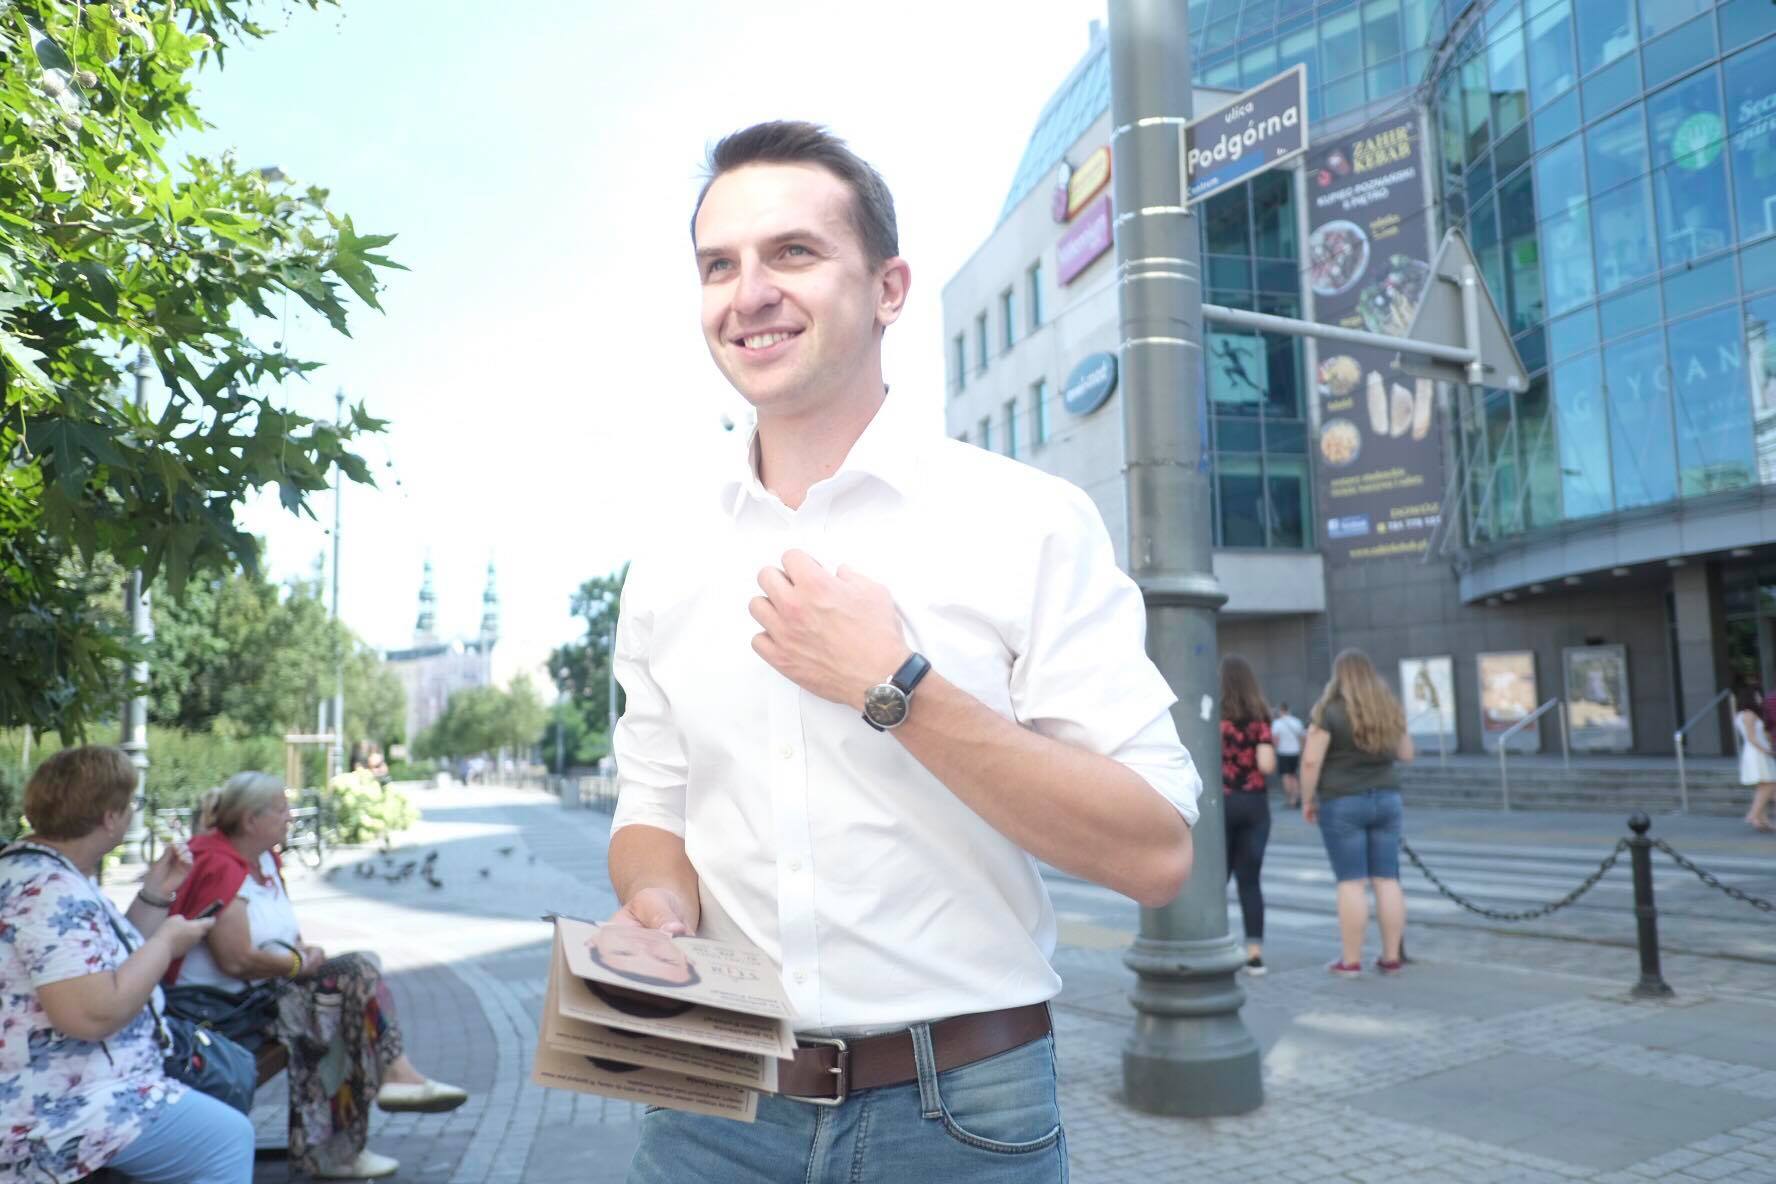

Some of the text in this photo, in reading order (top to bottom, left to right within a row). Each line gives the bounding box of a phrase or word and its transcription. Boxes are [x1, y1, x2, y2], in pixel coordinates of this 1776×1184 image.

[1225, 101, 1254, 123] ulica
[1188, 106, 1298, 175] Podgórna
[1353, 142, 1412, 173] KEBAB
[1572, 340, 1742, 418] GYCAN
